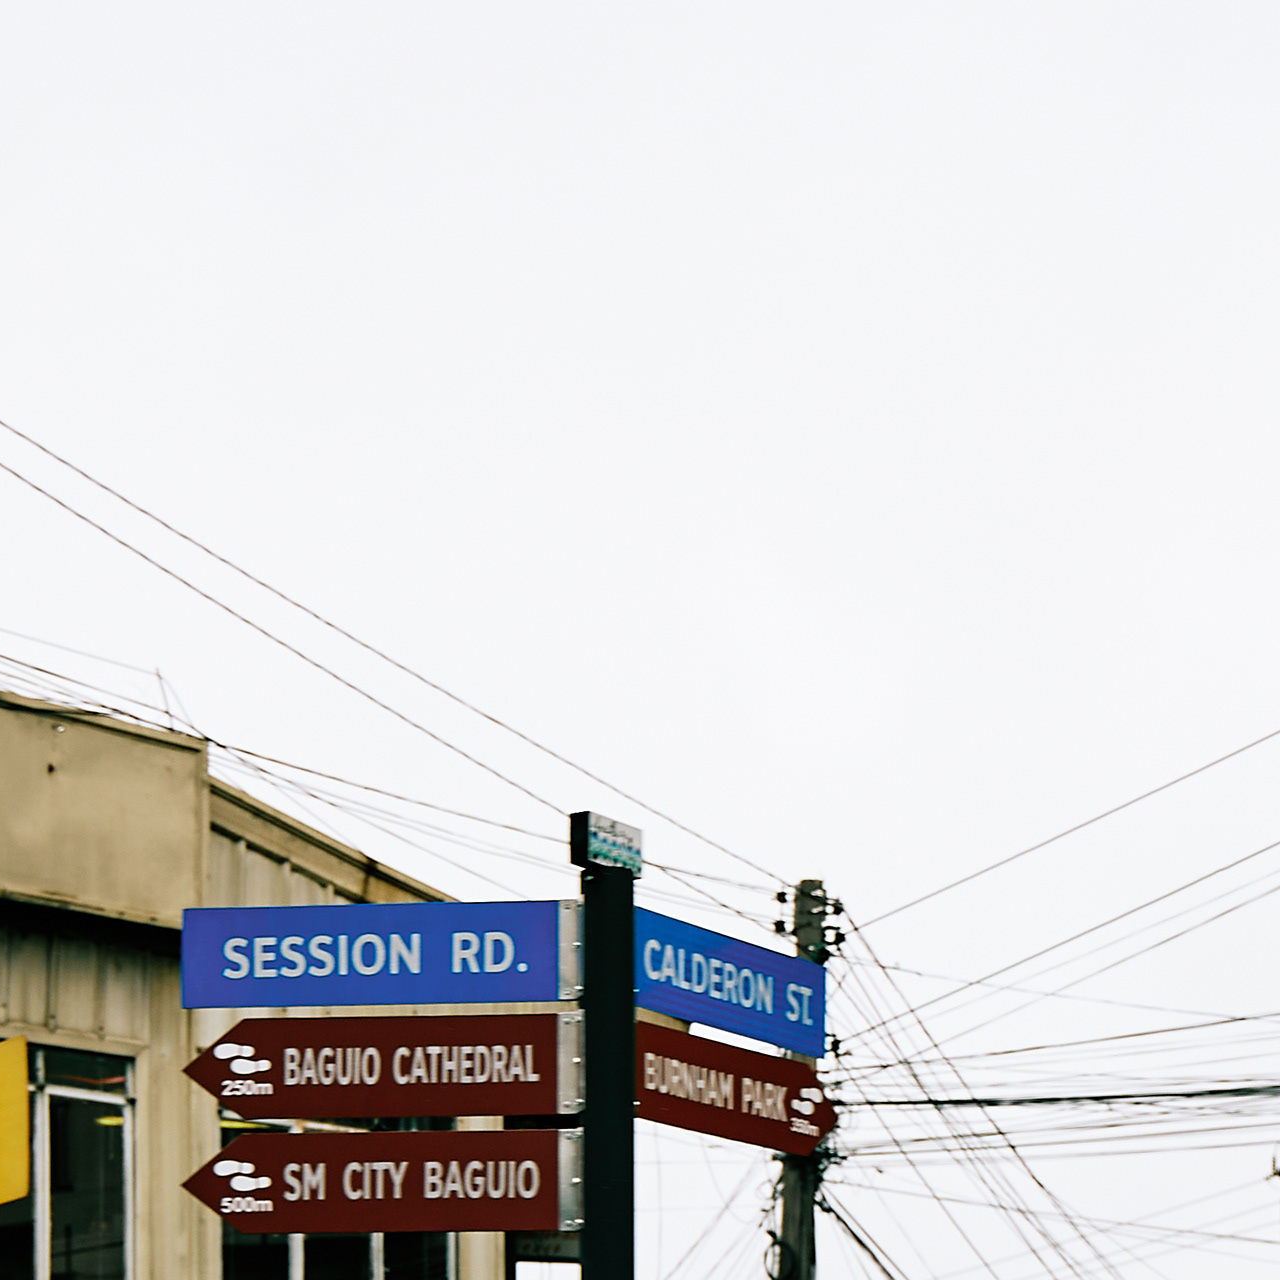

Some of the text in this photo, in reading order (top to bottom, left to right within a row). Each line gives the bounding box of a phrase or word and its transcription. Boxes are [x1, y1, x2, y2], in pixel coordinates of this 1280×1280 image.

[222, 931, 530, 980] SESSION RD.
[643, 938, 775, 1015] CALDERON
[283, 1043, 541, 1085] BAGUIO CATHEDRAL
[220, 1079, 274, 1096] 250m
[644, 1052, 789, 1122] BURNHAM PARK
[282, 1160, 541, 1201] SM CITY BAGUIO
[220, 1196, 274, 1213] 500m
